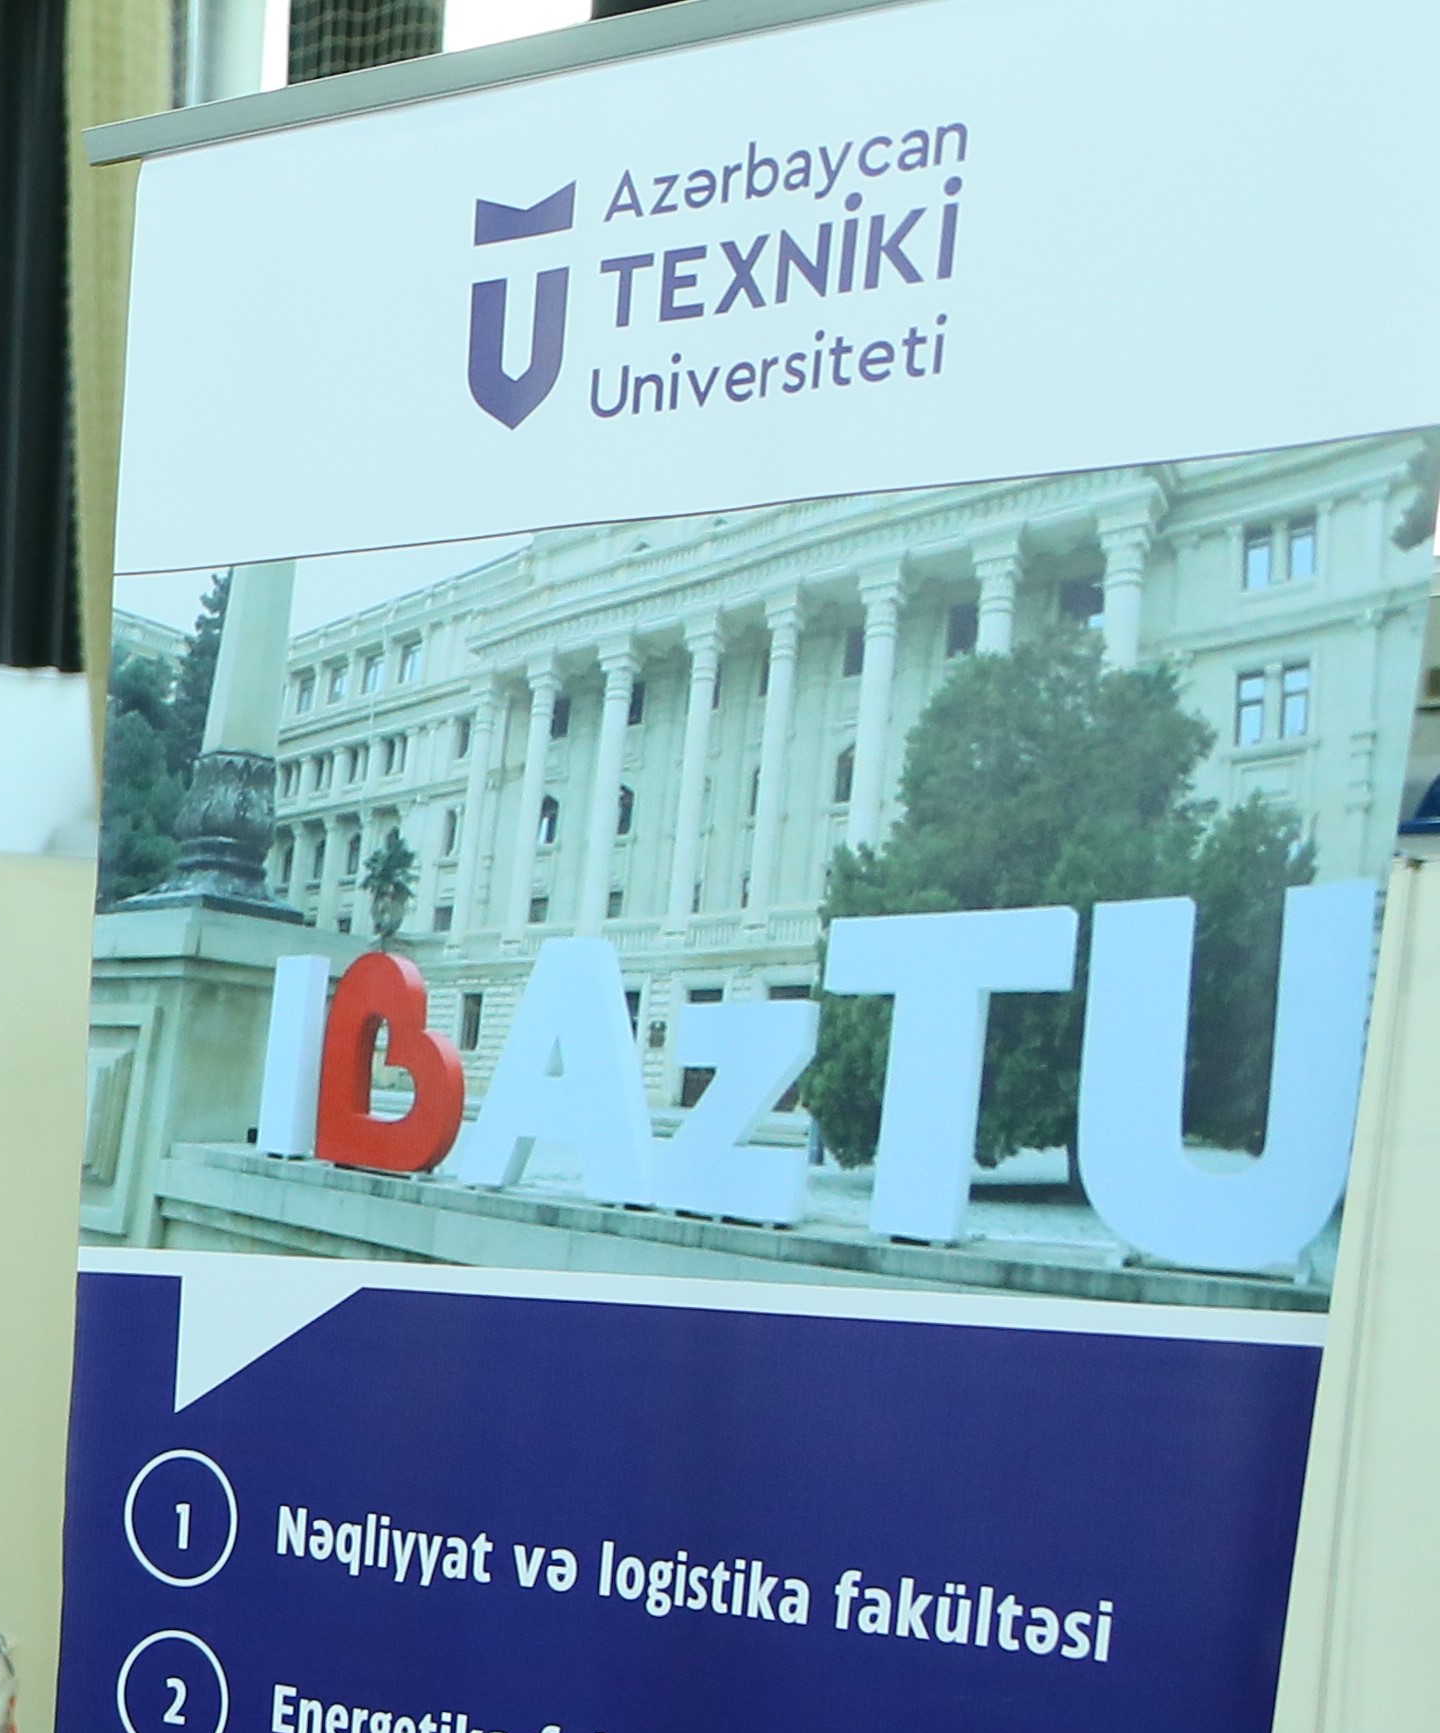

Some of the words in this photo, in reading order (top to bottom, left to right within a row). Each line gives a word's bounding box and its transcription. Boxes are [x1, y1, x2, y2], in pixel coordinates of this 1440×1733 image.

[603, 120, 968, 225] Azərbaycan
[600, 176, 962, 328] TEXNİKİ
[589, 314, 948, 419] Universiteti
[174, 1501, 192, 1550] 1
[274, 1504, 493, 1587] Nəqliyyat
[513, 1545, 578, 1594] və
[598, 1541, 810, 1627] logistika
[833, 1570, 1114, 1663] fakültəsi
[161, 1677, 189, 1725] 2
